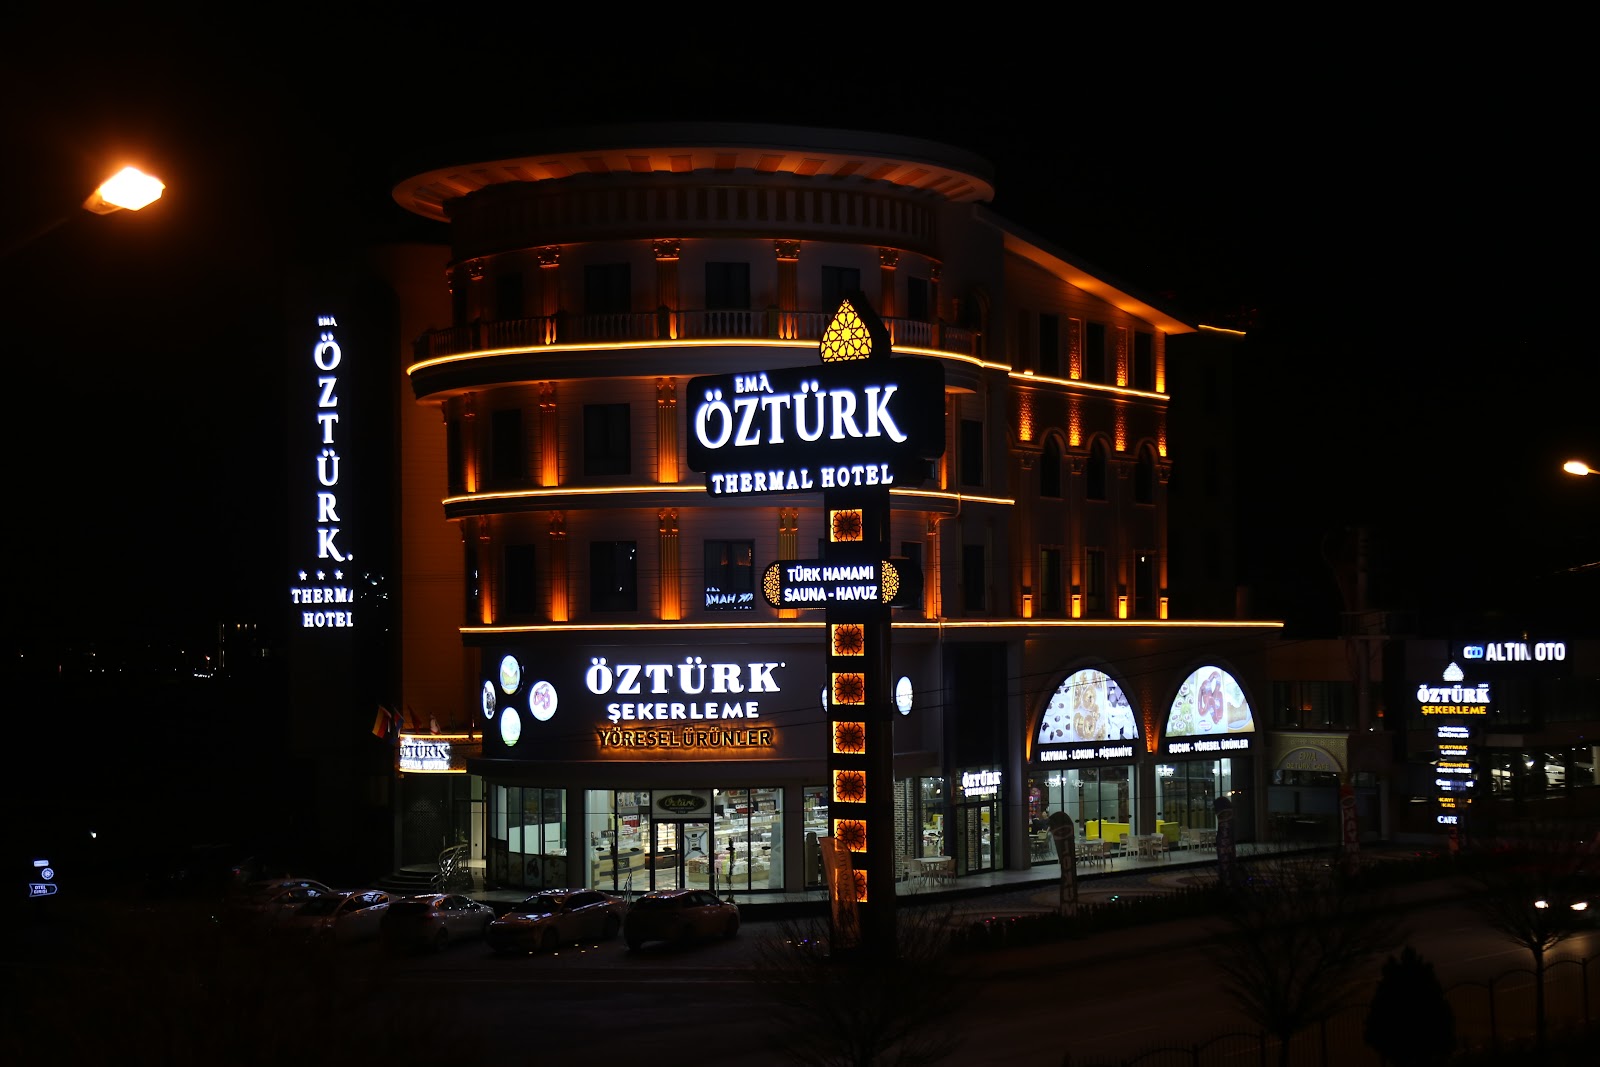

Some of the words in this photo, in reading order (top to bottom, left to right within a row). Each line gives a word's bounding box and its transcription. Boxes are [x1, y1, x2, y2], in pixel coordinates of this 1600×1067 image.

[318, 316, 338, 327] EMA
[735, 374, 774, 394] EMA
[695, 381, 908, 449] ÖZTÜRK
[314, 332, 353, 562] ÖZTÜRK
[711, 470, 813, 494] THERMAL
[821, 464, 893, 487] HOTEL
[787, 565, 821, 582] TÜRK
[823, 565, 874, 581] HAMAMI
[784, 588, 827, 602] SAUNA
[836, 586, 877, 601] HAVUZ
[303, 612, 354, 628] HOTEL
[1485, 642, 1531, 661] ALTIN
[1534, 642, 1566, 661] OTO
[586, 656, 782, 694] ÖZTÜRK
[1417, 684, 1490, 703] ÖZTÜRK
[607, 701, 759, 723] ŞEKERLEME
[1421, 705, 1487, 716] ŞEKERLEME
[600, 727, 680, 748] YÖRESEL
[683, 727, 773, 747] ÜRÜNLER
[1168, 743, 1190, 754] SUCUK
[1194, 740, 1220, 752] YÖRESEL
[1221, 738, 1249, 750] ÜRÜNLER
[1040, 750, 1068, 762] KAYMAK
[1072, 748, 1095, 760] LOKUM
[1099, 745, 1133, 760] PİŞMANİYE
[962, 770, 1002, 788] ÖZTÜRK
[1437, 815, 1458, 824] CAFE
